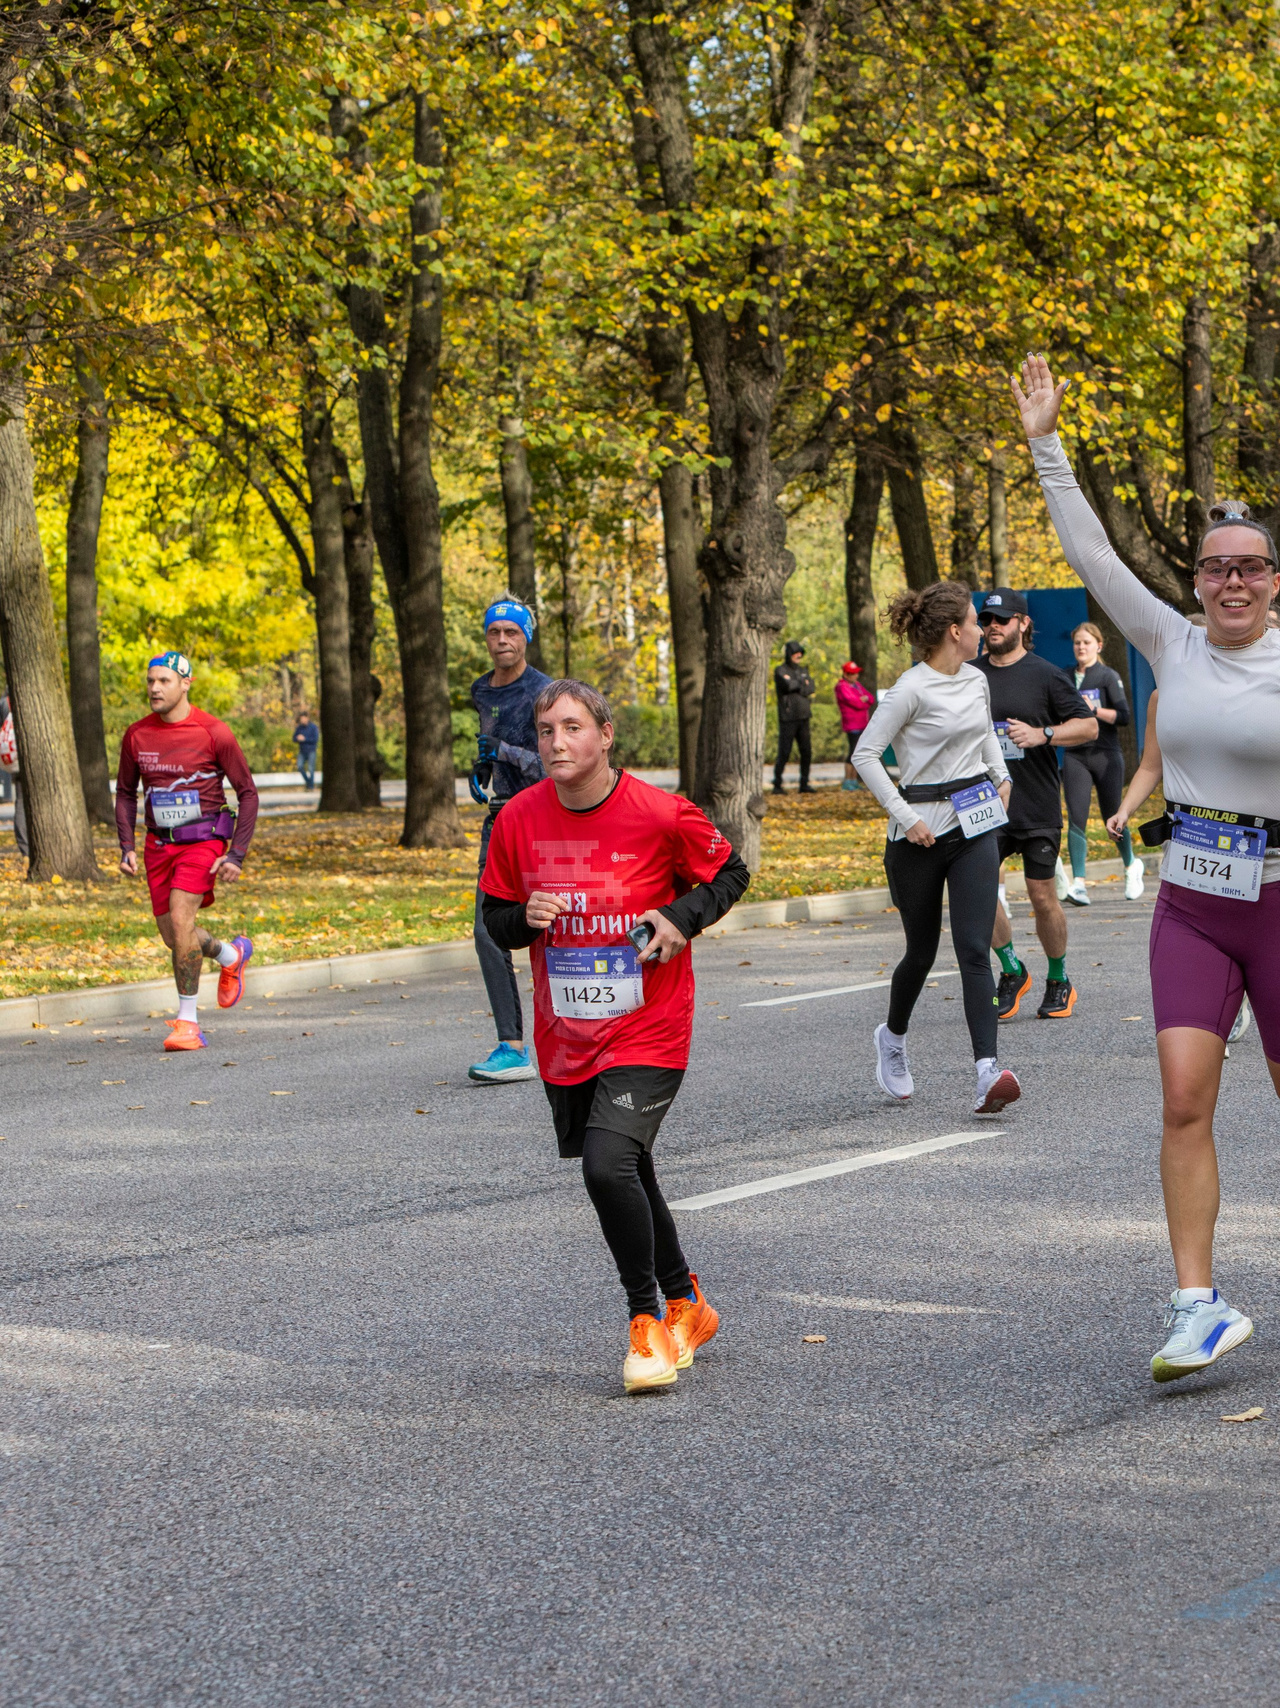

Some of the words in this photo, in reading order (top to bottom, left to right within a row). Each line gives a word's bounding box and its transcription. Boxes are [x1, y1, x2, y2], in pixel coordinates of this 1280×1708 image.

[162, 810, 187, 819] 13712
[968, 806, 994, 825] 12212
[1190, 807, 1239, 823] RUNLAB
[1183, 854, 1232, 880] 11374
[562, 986, 616, 1004] 11423
[612, 1098, 635, 1111] adidas
